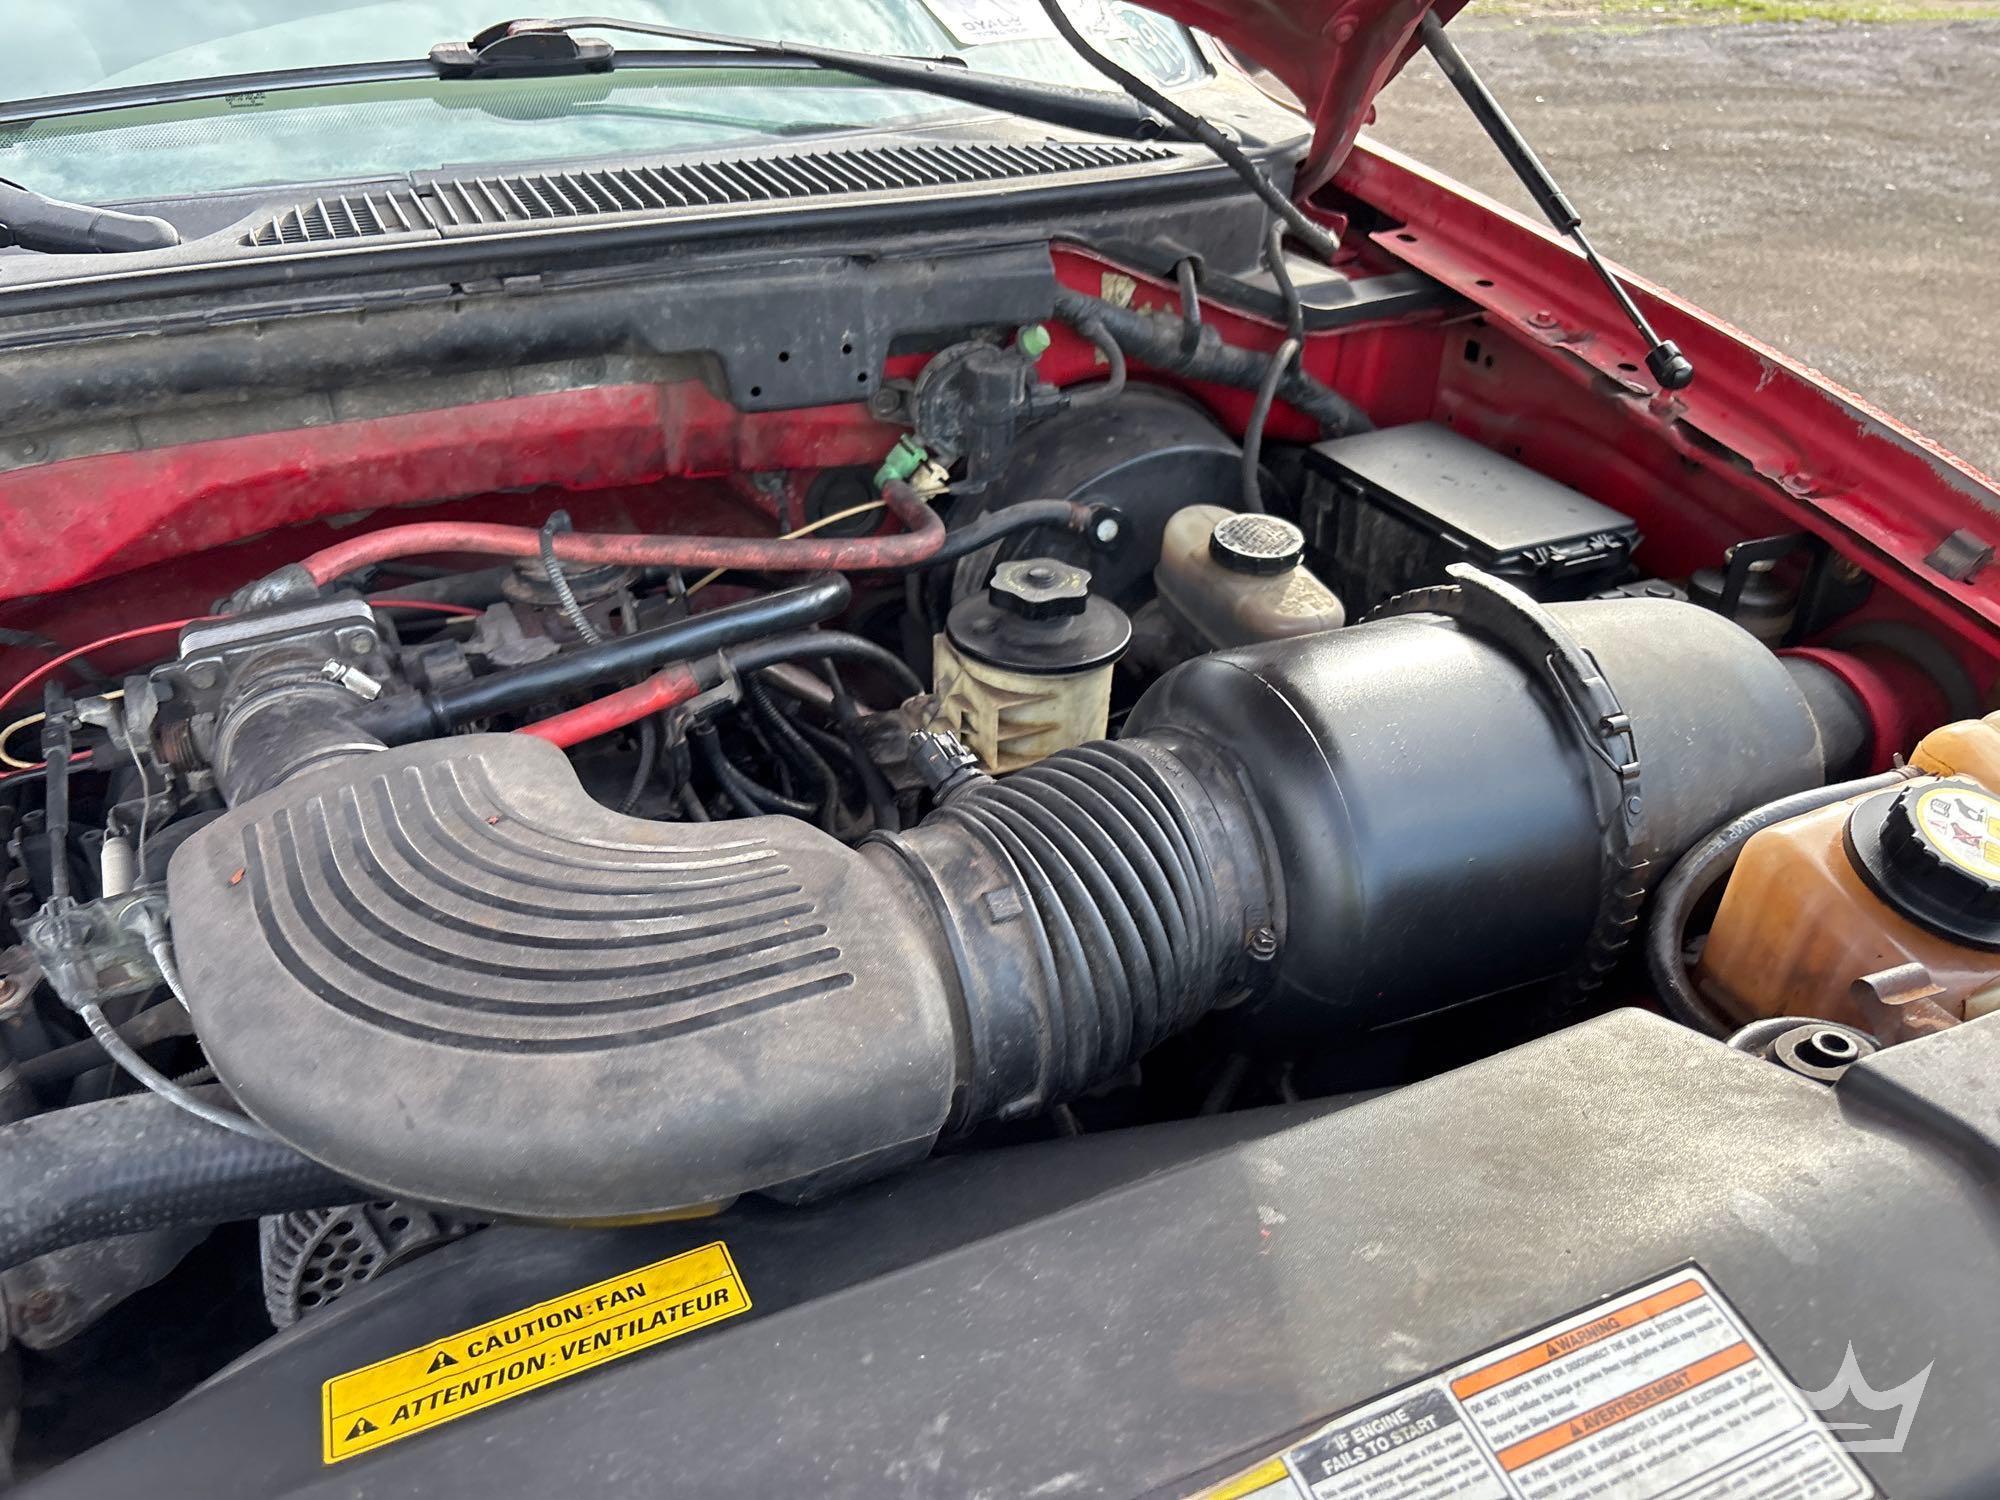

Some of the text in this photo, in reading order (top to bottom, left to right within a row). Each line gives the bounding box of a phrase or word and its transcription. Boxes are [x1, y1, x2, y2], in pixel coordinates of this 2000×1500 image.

[594, 1282, 646, 1312] FAN
[561, 1287, 730, 1361] VENTILATEUR
[1555, 1316, 1620, 1351] WARNING
[1483, 1395, 1500, 1407] NOT
[1500, 1381, 1532, 1400] TAMPER
[1532, 1372, 1552, 1386] WITH
[1552, 1366, 1566, 1377] OR
[1564, 1347, 1610, 1371] DISCONNECT
[1609, 1340, 1626, 1352] THE
[1654, 1314, 1684, 1332] SYSTEM
[1540, 1390, 1554, 1401] the
[1580, 1372, 1692, 1430] AVERTISSEMENT
[1320, 1415, 1439, 1475] FAILS TO START
[1333, 1408, 1411, 1450] IF ENGINE
